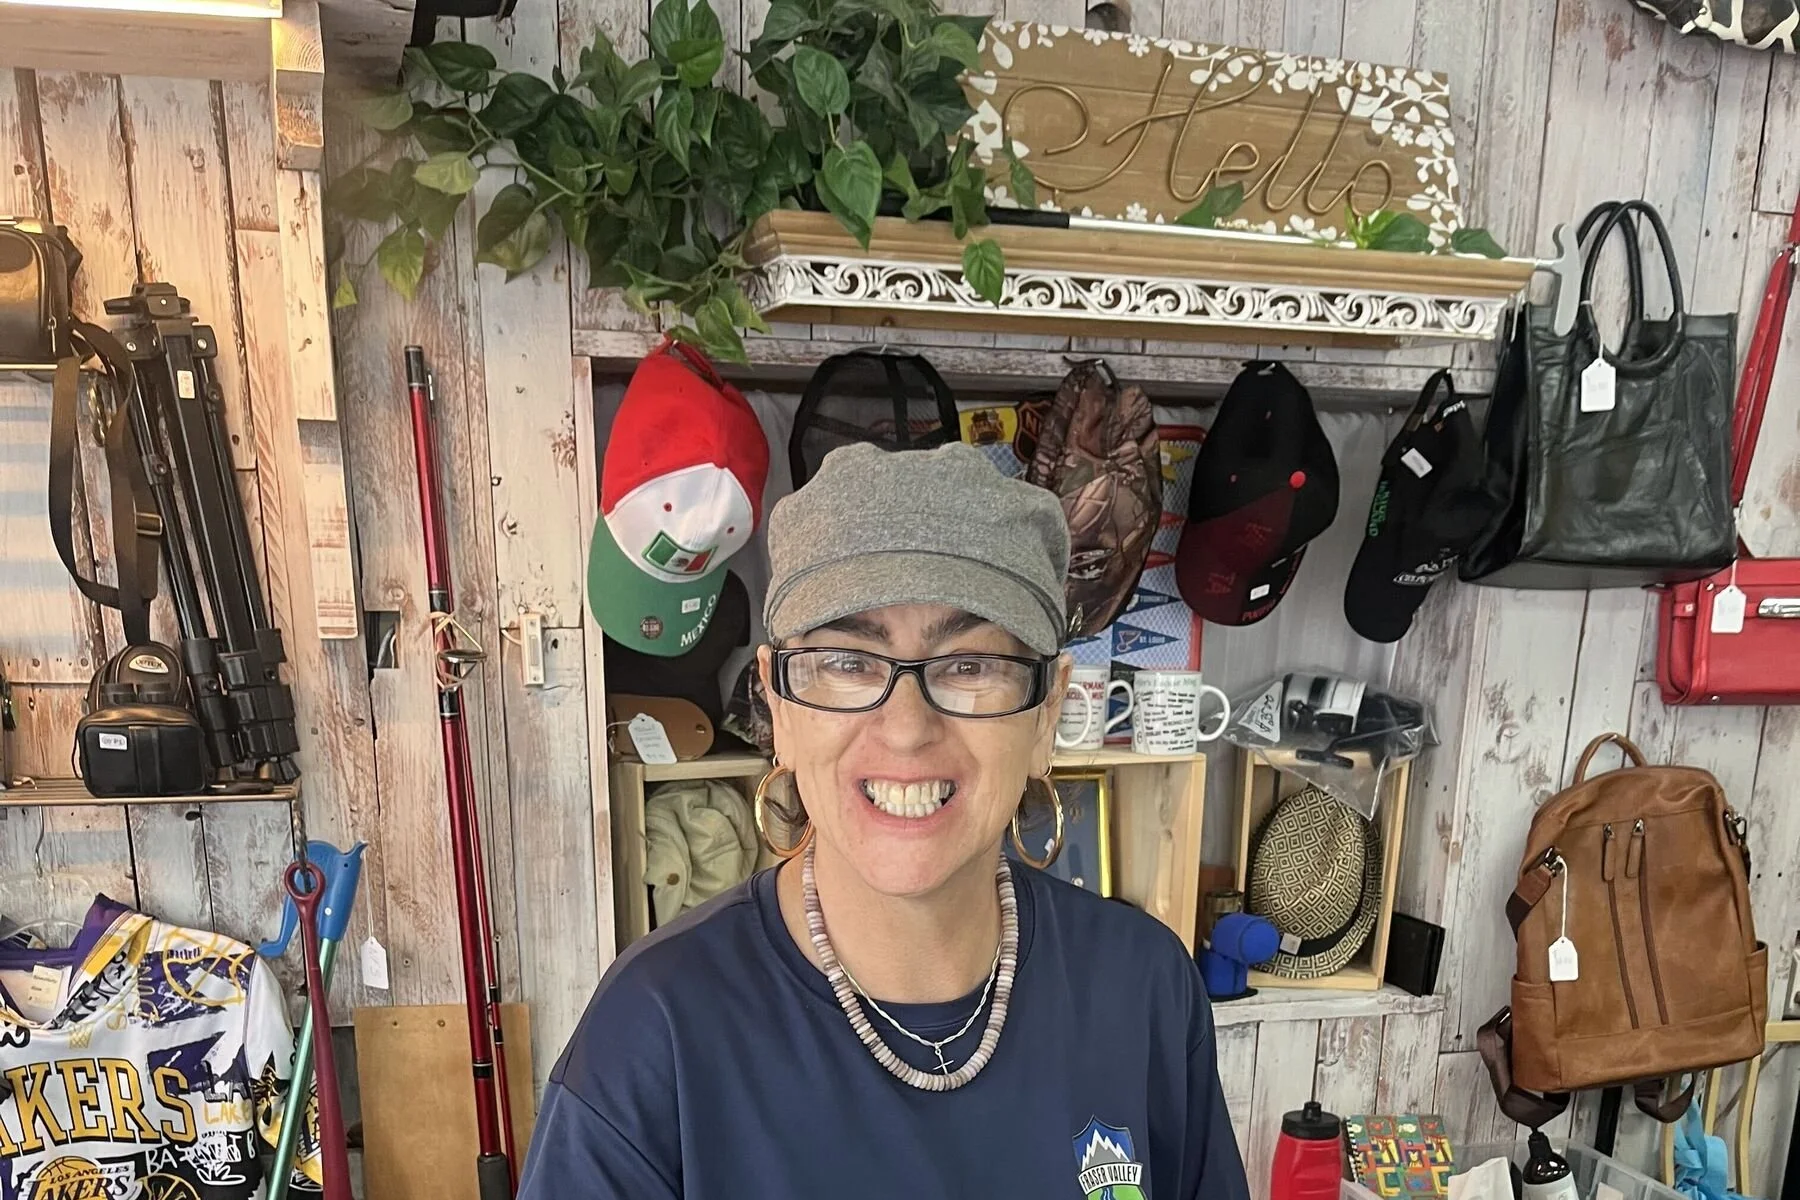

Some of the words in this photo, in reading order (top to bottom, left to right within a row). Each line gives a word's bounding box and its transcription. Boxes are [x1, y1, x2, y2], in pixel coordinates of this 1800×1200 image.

[1001, 48, 1395, 217] Hello
[680, 593, 717, 648] MEXICO
[50, 1174, 70, 1184] LOS
[75, 1164, 130, 1178] ANGELES
[1081, 1168, 1107, 1192] FRASER
[1107, 1165, 1139, 1183] VALLEY
